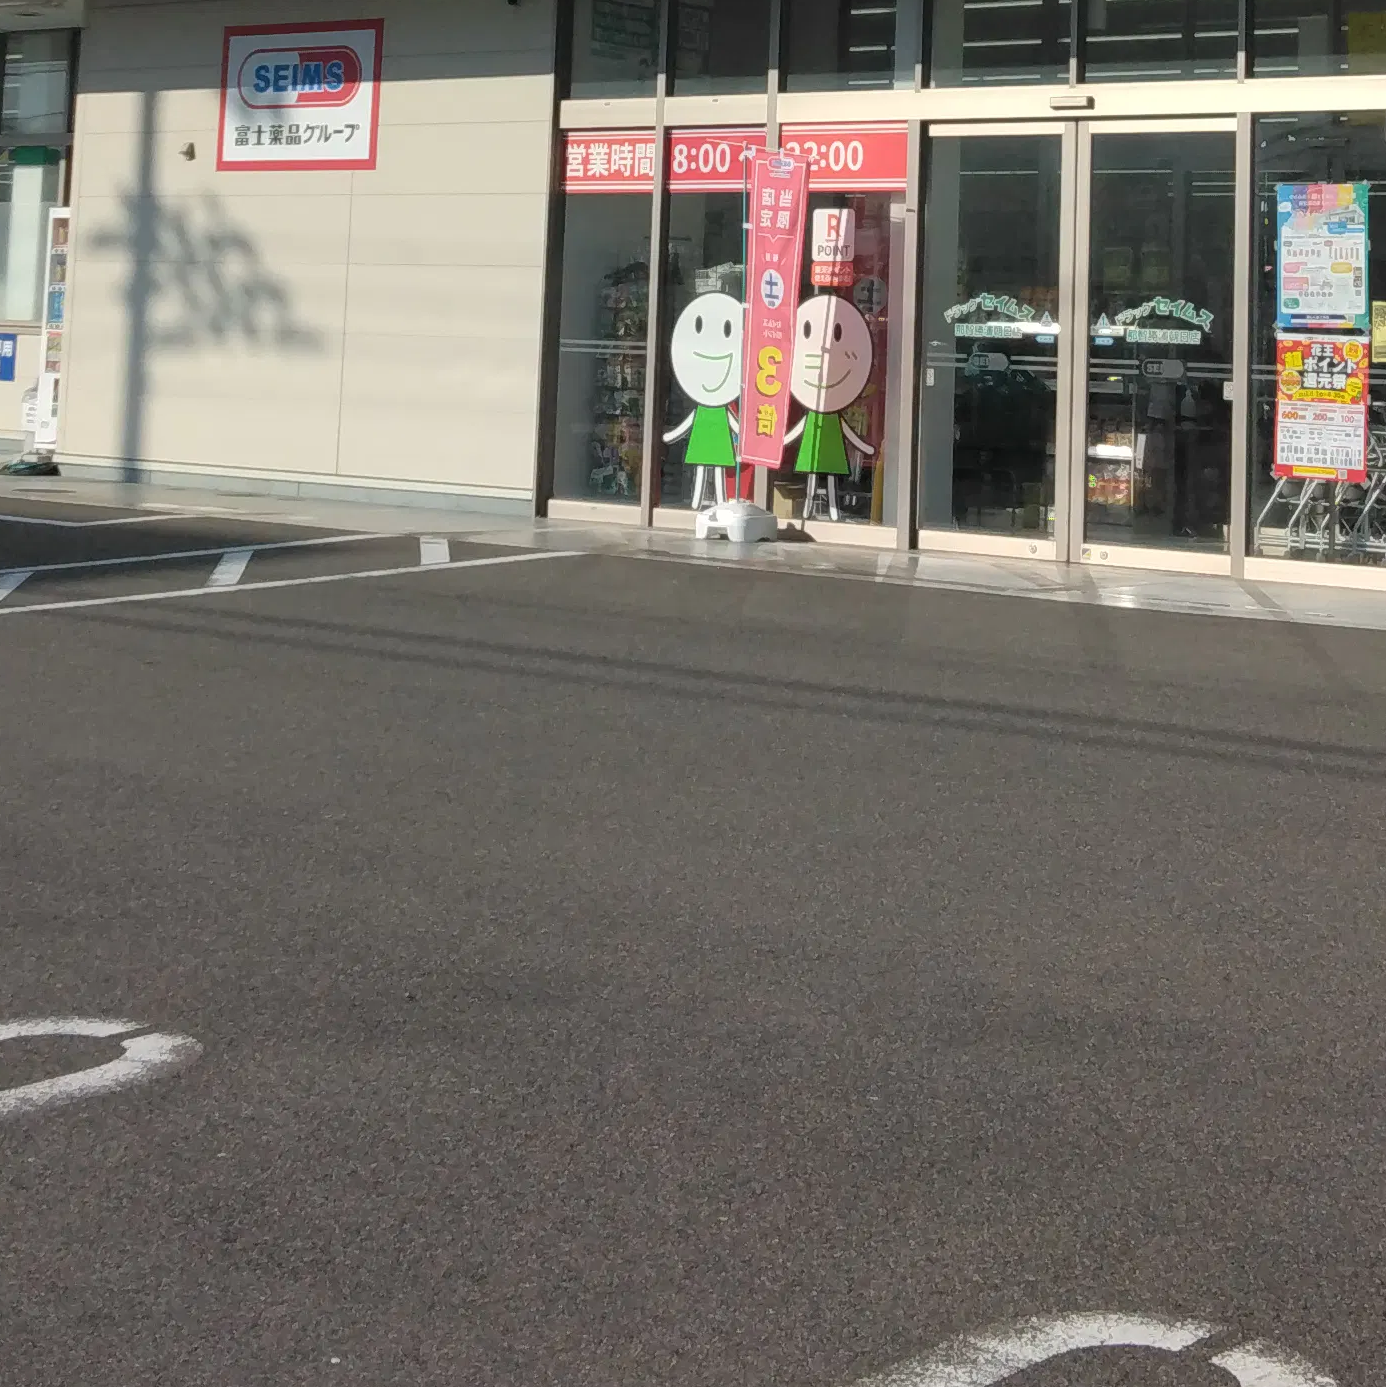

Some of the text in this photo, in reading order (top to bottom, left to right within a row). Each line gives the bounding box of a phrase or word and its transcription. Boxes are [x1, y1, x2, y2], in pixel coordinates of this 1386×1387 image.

[253, 60, 345, 94] SEIMS
[234, 121, 361, 147] 富士薬品グループ
[565, 142, 655, 179] 営業時間
[816, 244, 851, 257] POINT
[1153, 296, 1214, 333] セイムス
[1304, 356, 1357, 374] ポイント
